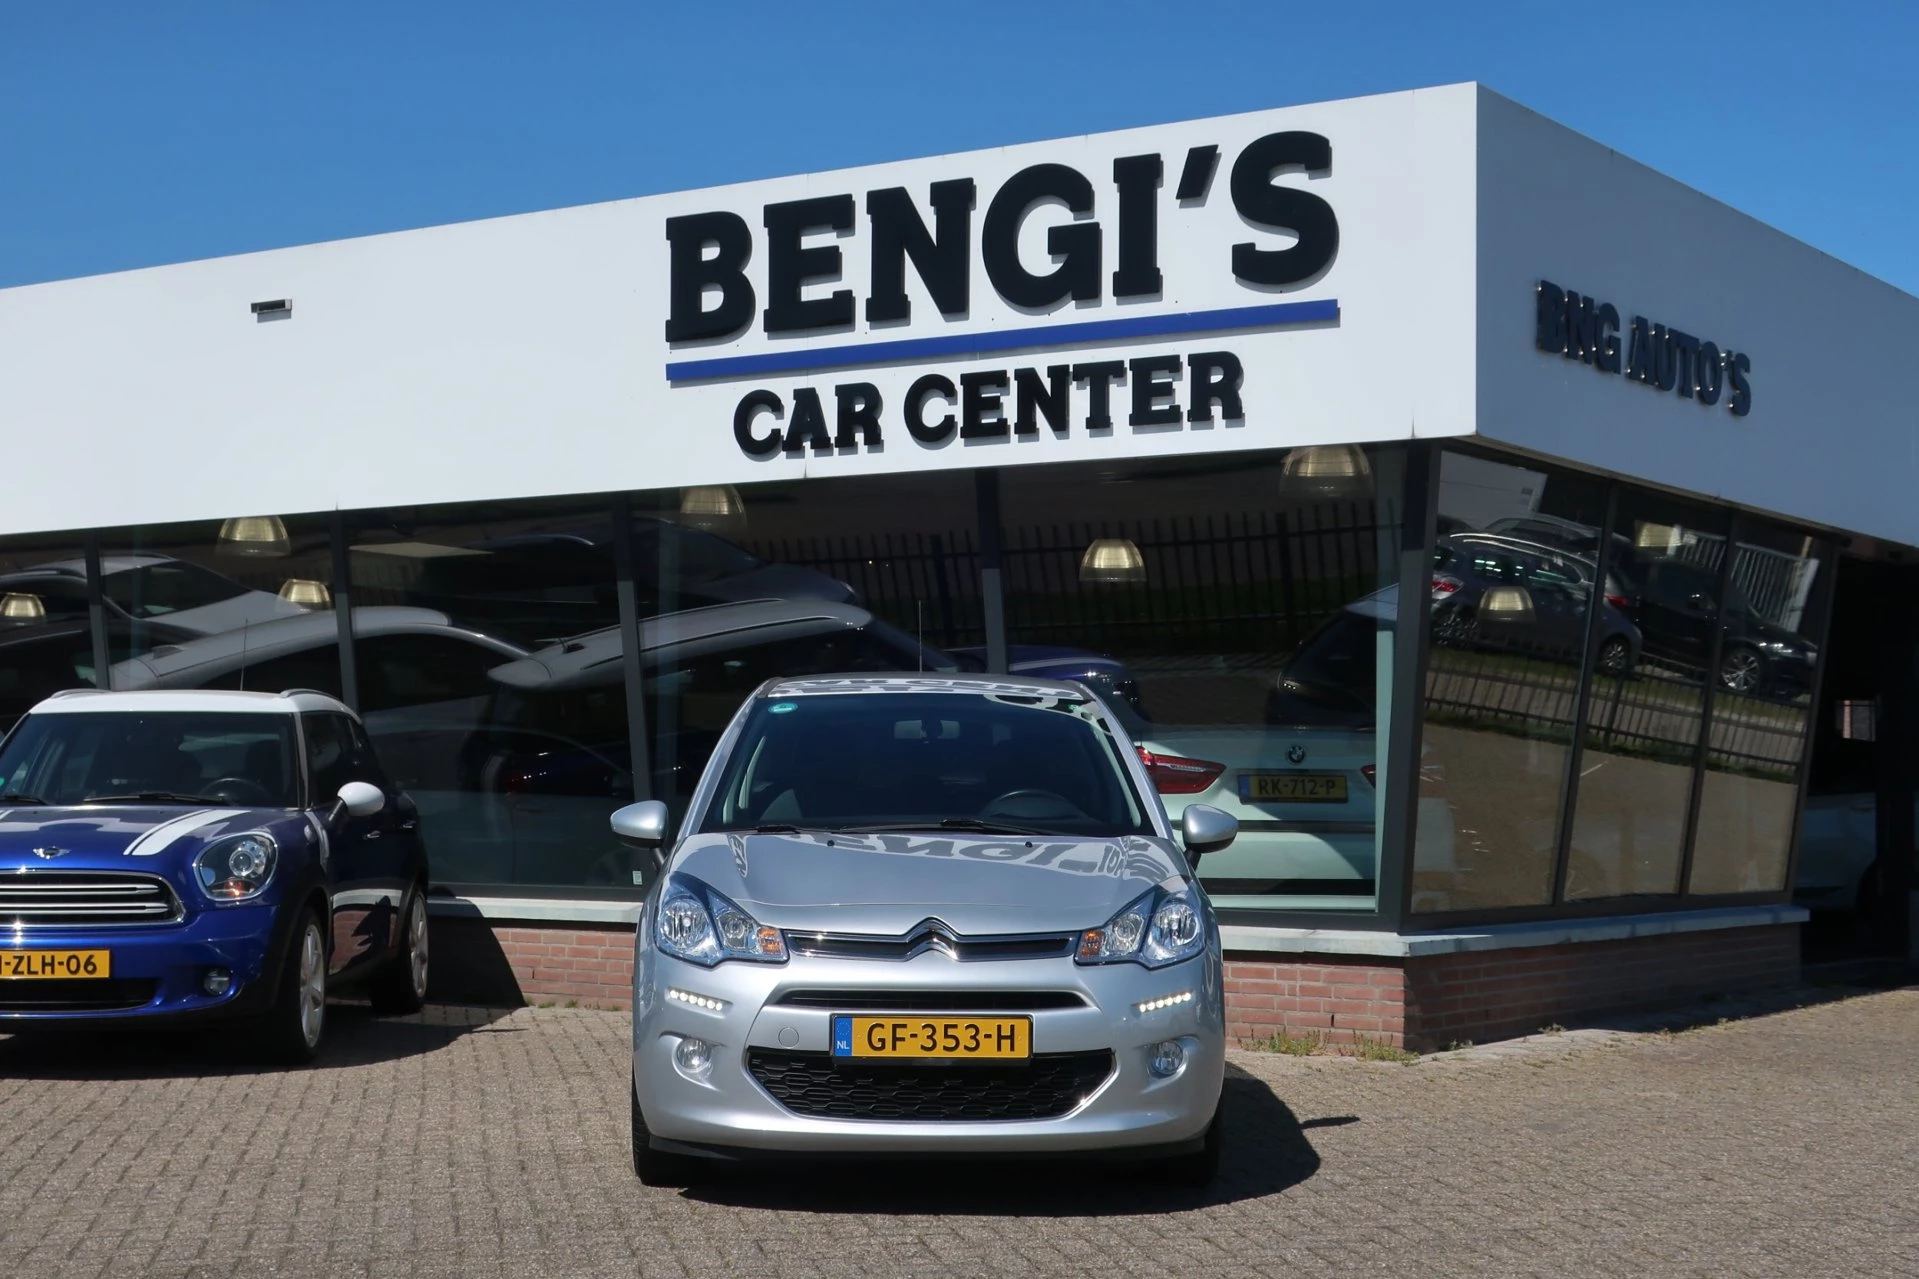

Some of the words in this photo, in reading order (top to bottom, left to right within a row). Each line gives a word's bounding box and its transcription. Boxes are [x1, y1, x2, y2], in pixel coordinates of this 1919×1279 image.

[665, 130, 1340, 343] BENGI'S
[1536, 279, 1621, 374] BNG
[1625, 315, 1751, 417] AUTO'S
[733, 382, 883, 455] CAR
[903, 350, 1244, 443] CENTER
[1258, 778, 1336, 796] RK-712-P
[0, 954, 98, 976] -ZLH-06
[836, 1040, 850, 1050] NL
[866, 1022, 1016, 1053] GF-353-H
